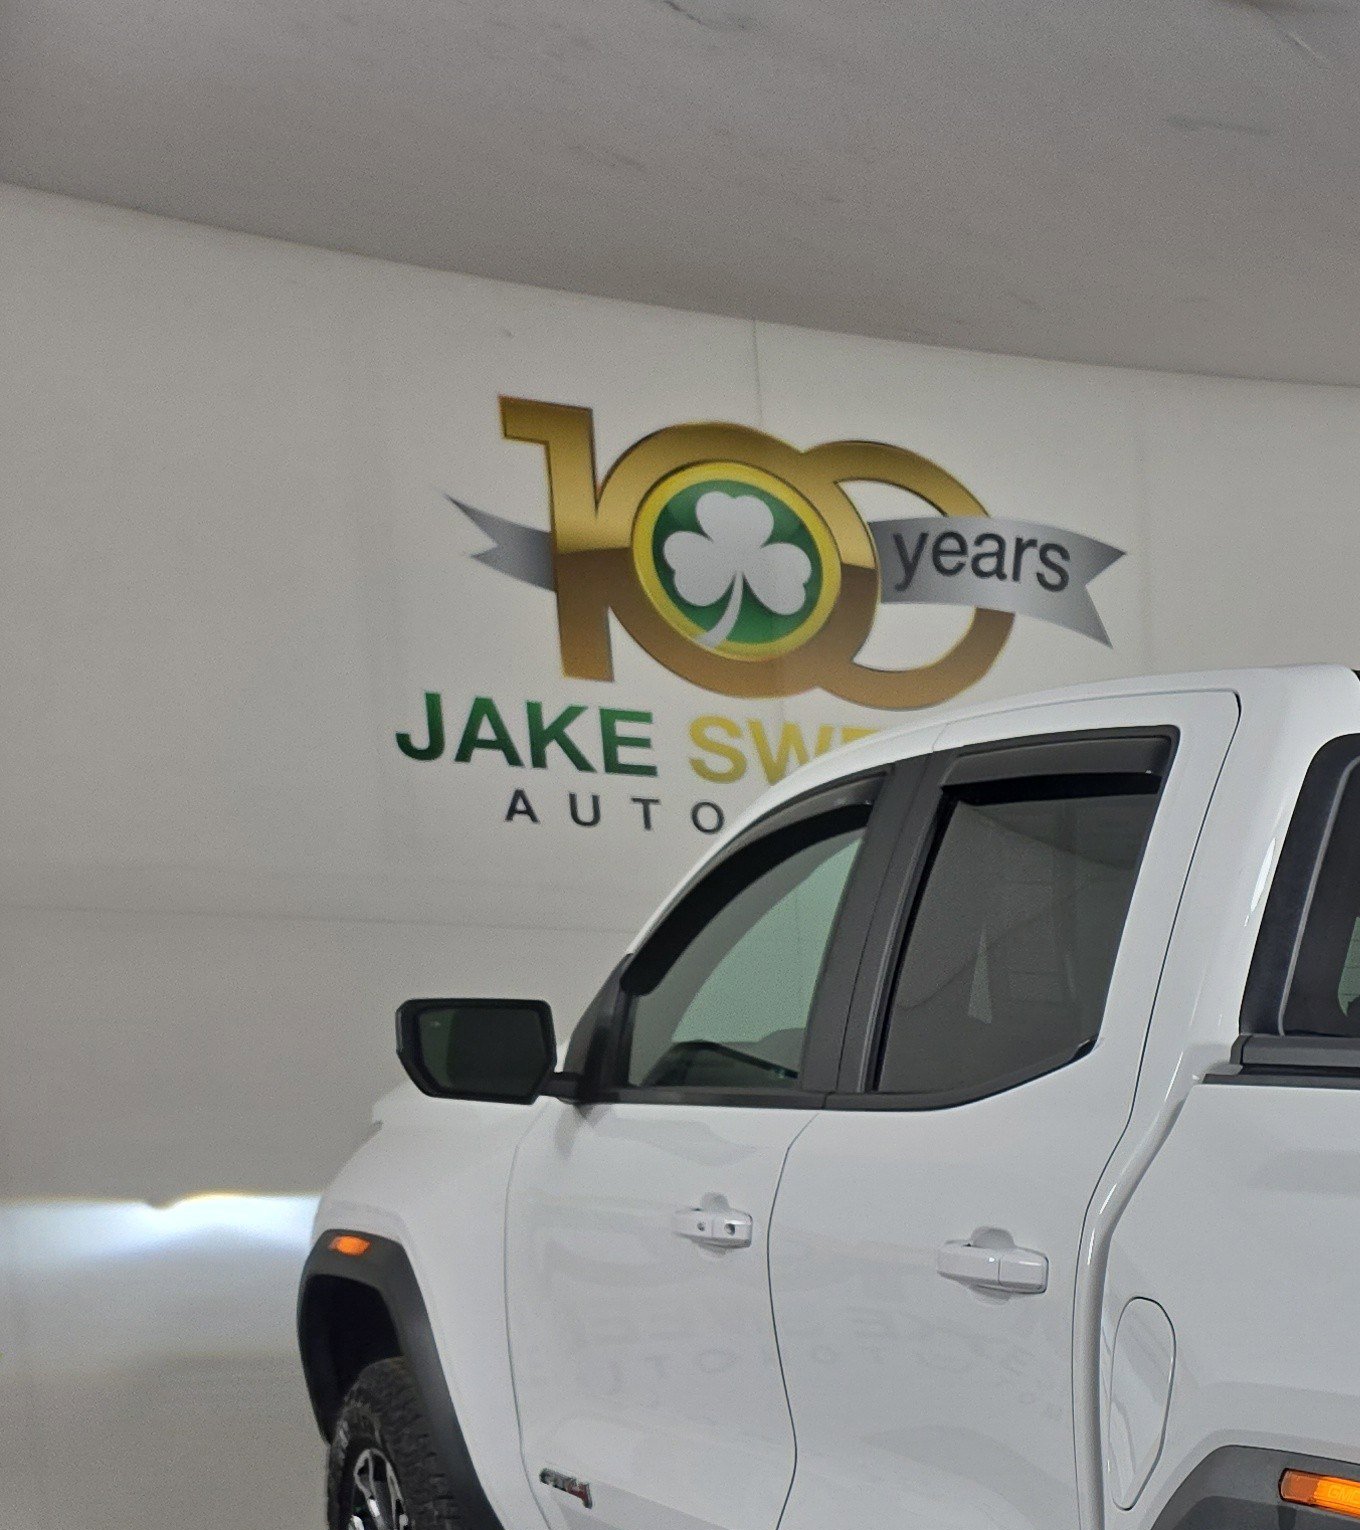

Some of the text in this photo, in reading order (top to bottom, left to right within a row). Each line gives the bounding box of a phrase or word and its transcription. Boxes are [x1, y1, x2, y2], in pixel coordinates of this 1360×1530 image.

[497, 393, 1071, 712] 100 years
[395, 692, 658, 778] JAKE
